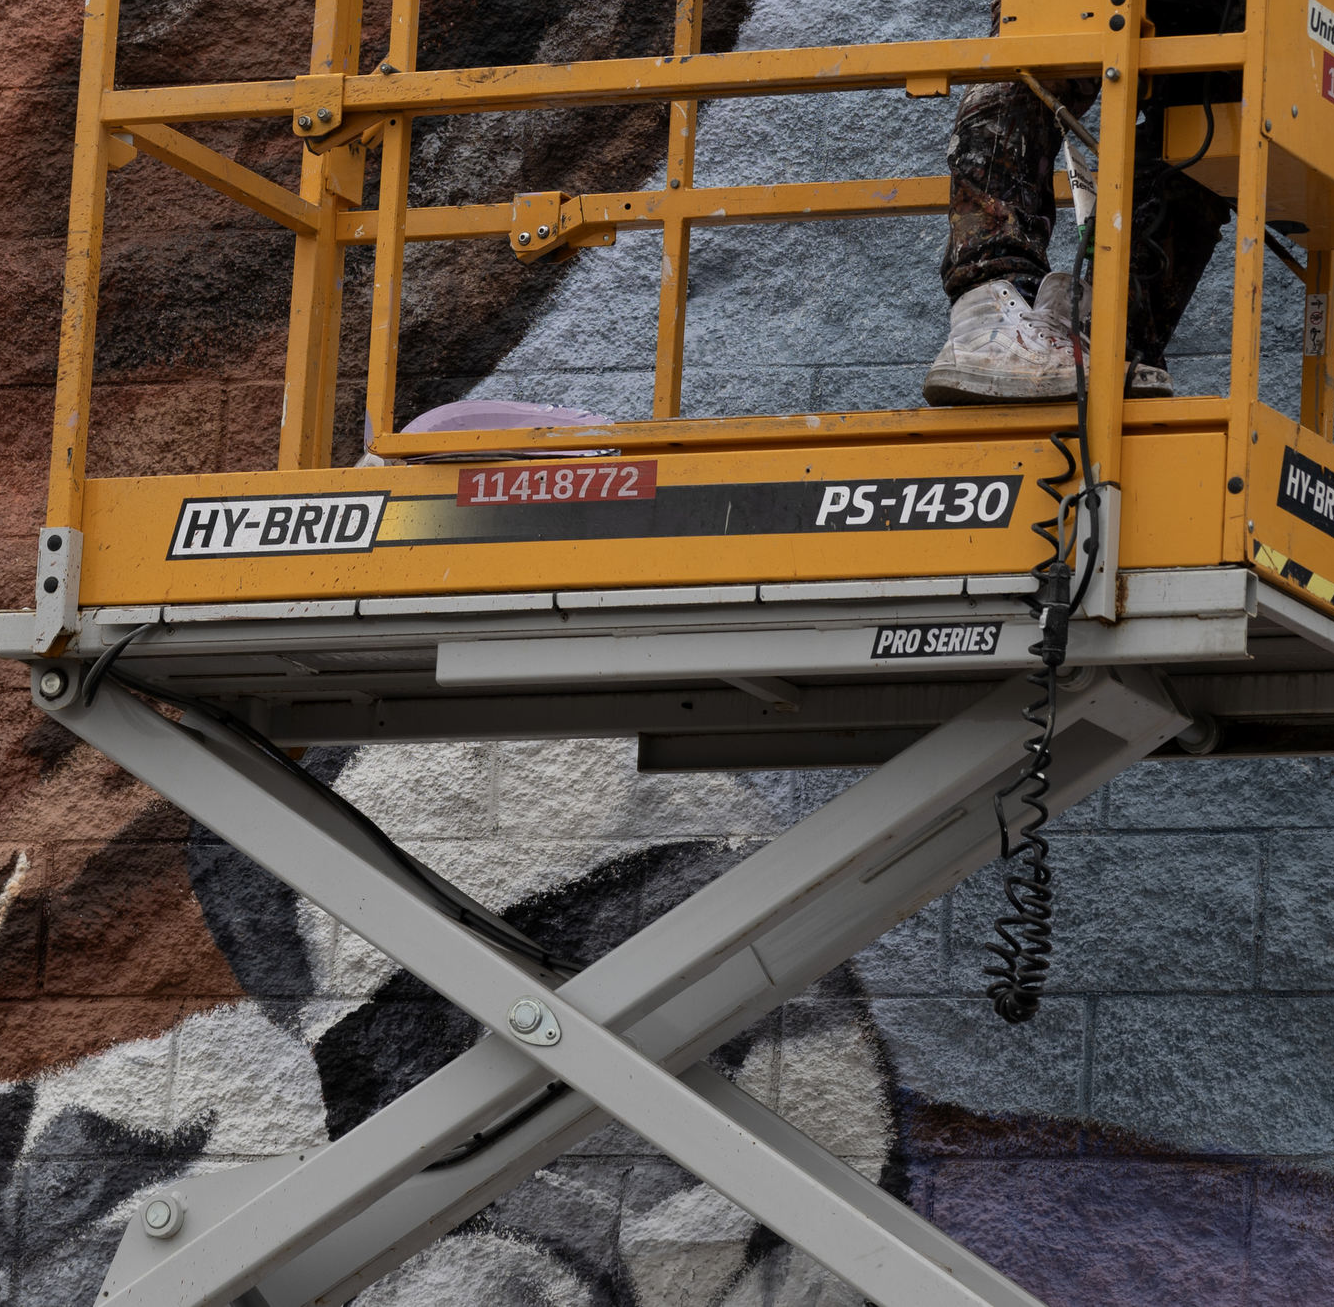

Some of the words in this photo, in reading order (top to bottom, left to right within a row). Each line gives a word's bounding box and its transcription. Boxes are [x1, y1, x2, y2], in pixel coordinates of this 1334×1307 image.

[469, 466, 640, 503] 11418772
[814, 480, 1010, 526] PS-1430
[181, 502, 370, 549] HY-BRID
[875, 628, 922, 654] PRO
[923, 625, 997, 653] SERIES
